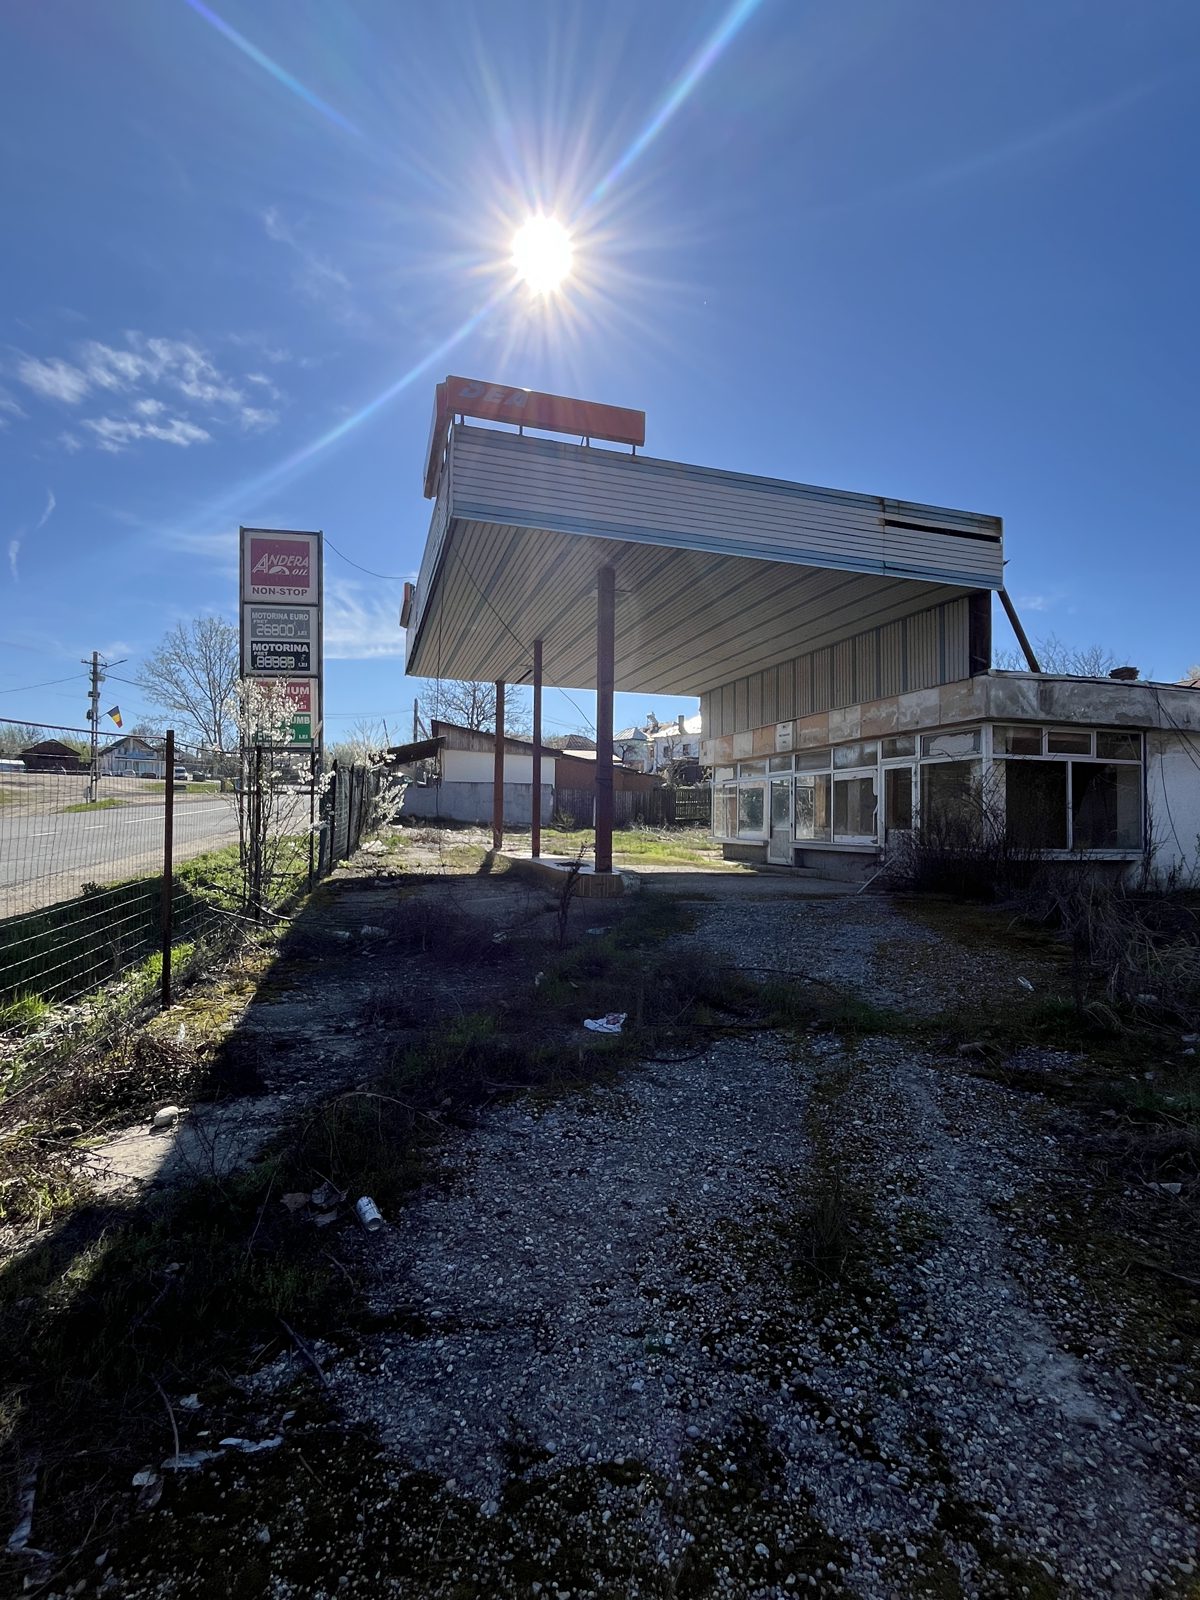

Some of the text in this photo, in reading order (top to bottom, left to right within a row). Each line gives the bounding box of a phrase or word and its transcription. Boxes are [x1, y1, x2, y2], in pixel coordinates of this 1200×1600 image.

[252, 553, 309, 573] ANDERA
[292, 568, 308, 576] OIL
[252, 587, 308, 596] NON-STOP
[256, 624, 295, 636] 26800
[252, 643, 309, 652] MOTORINA
